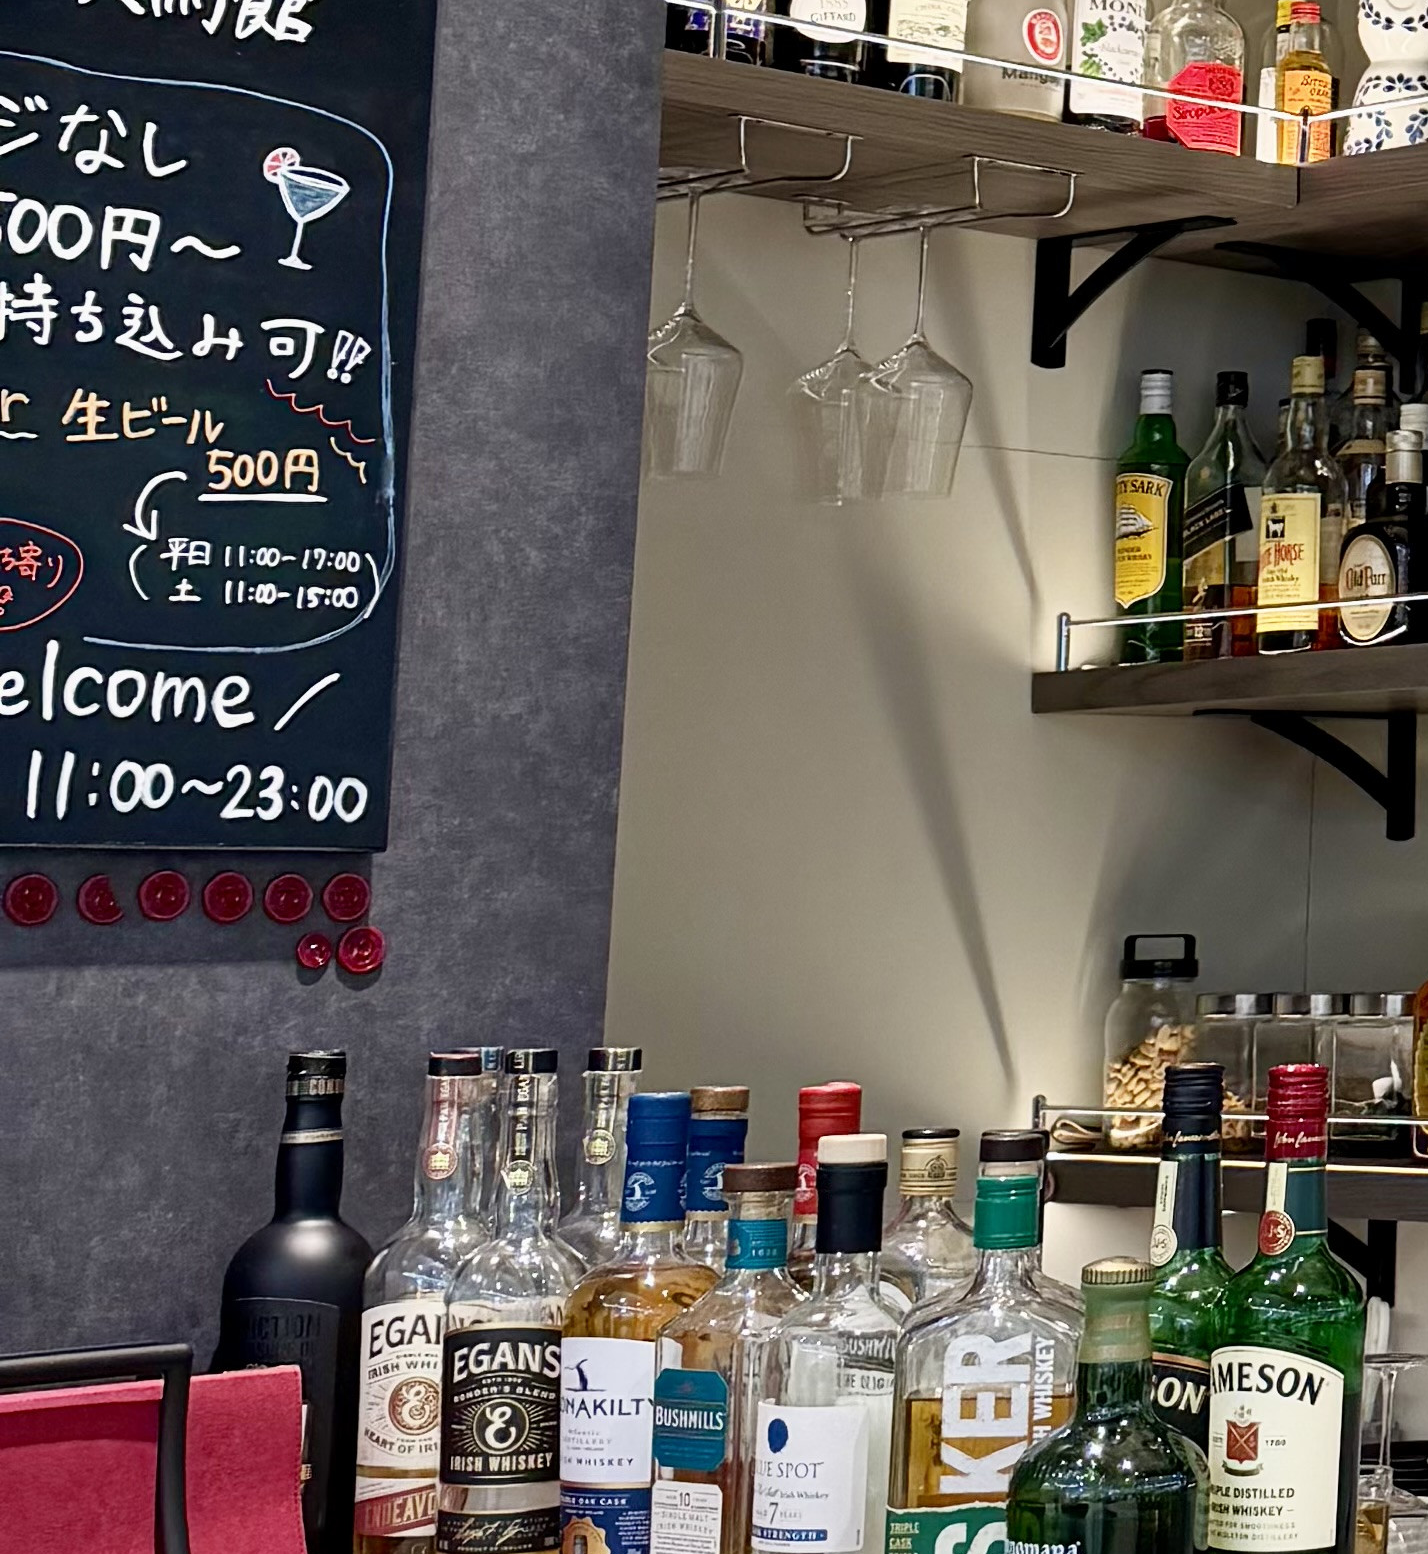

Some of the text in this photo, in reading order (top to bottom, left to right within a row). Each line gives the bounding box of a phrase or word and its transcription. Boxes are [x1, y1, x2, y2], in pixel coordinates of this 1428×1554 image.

[62, 388, 224, 445] 生ビール
[207, 449, 319, 493] 500円
[1131, 480, 1165, 497] SARK
[160, 538, 210, 571] 平日
[1274, 542, 1305, 564] HORSE
[1346, 566, 1387, 590] Old Parr
[169, 579, 201, 602] 土
[368, 1360, 400, 1380] IRISH
[453, 1342, 562, 1384] EGAN'S
[1034, 1336, 1056, 1424] WHISKEY
[655, 1405, 725, 1432] BUSHMILLS
[364, 1427, 415, 1455] HEART OF
[450, 1451, 554, 1473] IRISH WHISKEY
[576, 1457, 634, 1468] WHISKEY
[777, 1461, 824, 1479] SPOT
[678, 1490, 692, 1509] 10
[1233, 1486, 1296, 1500] DISTILLED
[768, 1501, 780, 1527] 7
[1232, 1505, 1284, 1518] WHISKEY
[890, 1522, 919, 1535] TRIPLE
[889, 1538, 913, 1549] CASK
